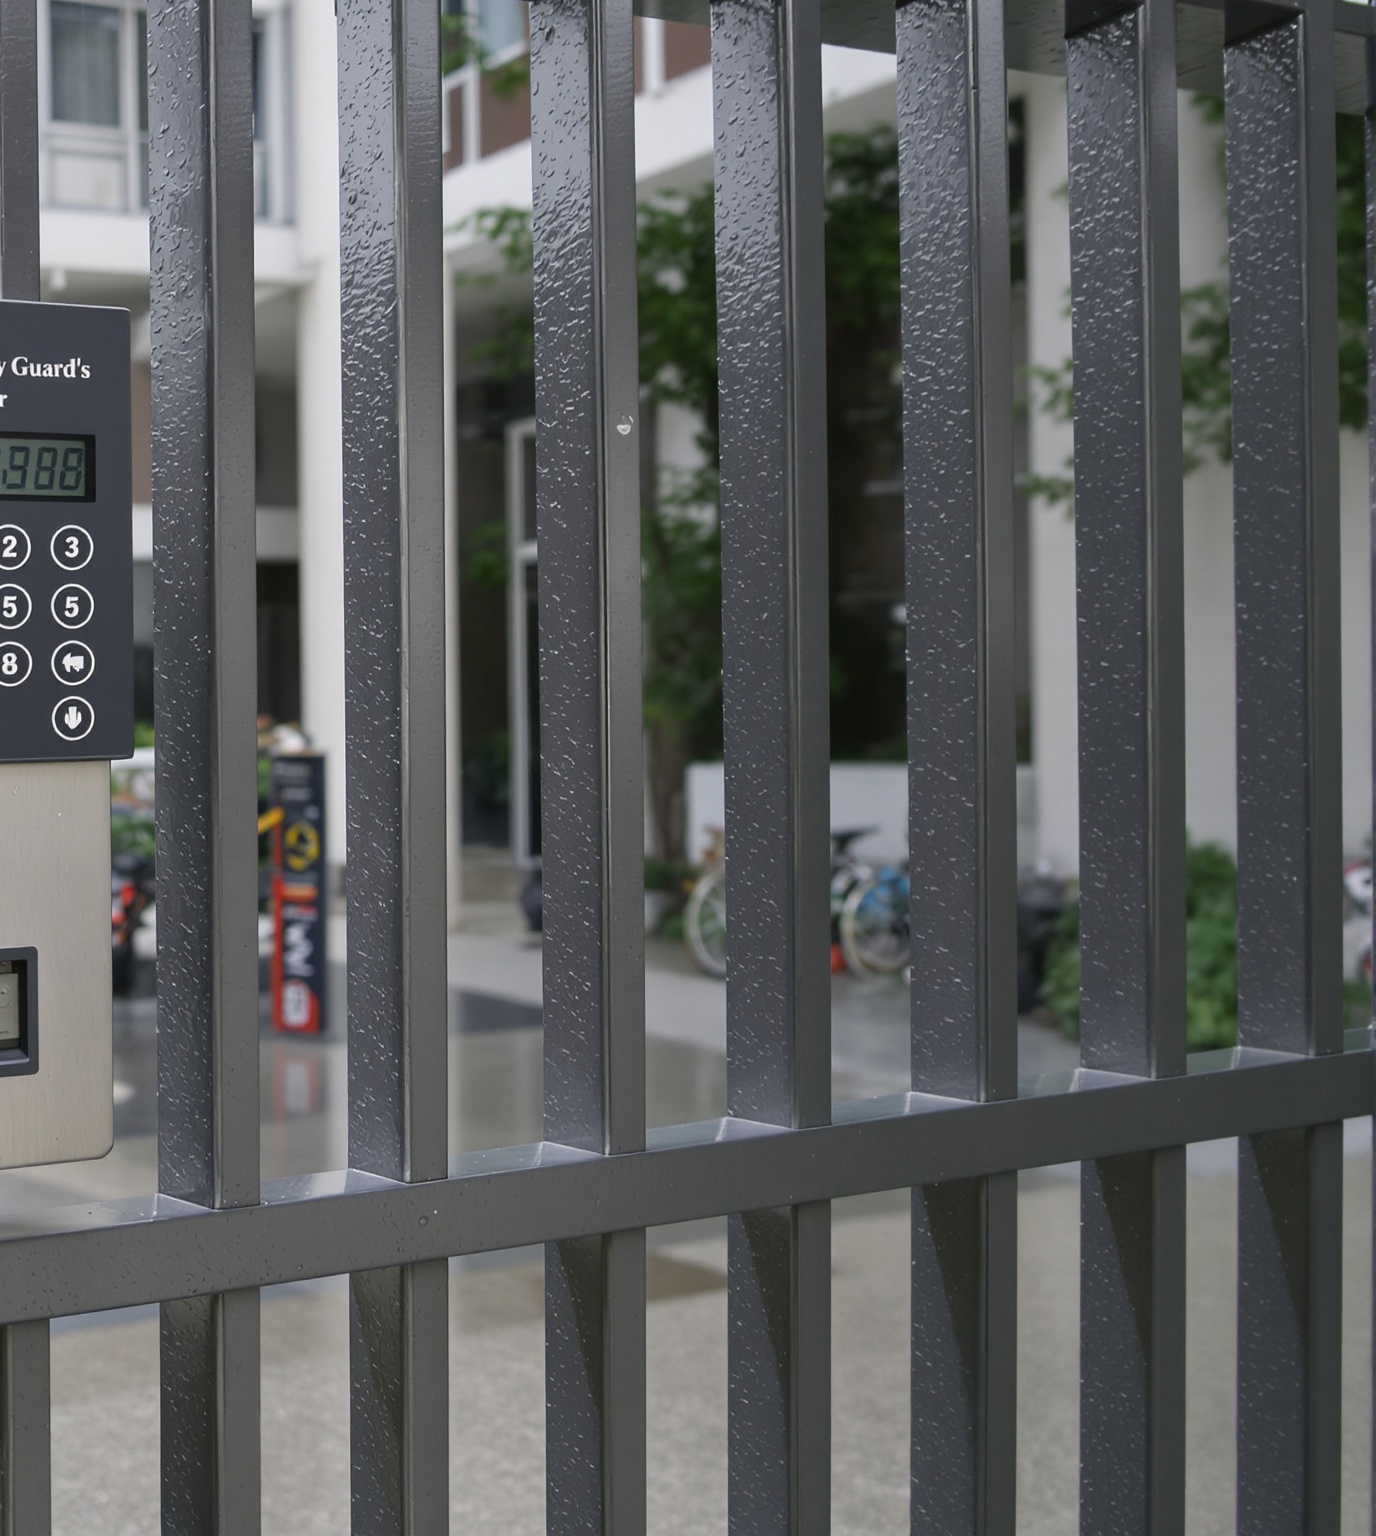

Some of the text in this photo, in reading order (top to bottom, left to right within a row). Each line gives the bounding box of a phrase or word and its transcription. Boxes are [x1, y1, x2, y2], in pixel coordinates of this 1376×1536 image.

[11, 356, 91, 379] Guard's
[2, 535, 18, 558] 2
[64, 536, 80, 558] 3
[2, 595, 18, 618] 5
[64, 596, 80, 618] 5
[1, 653, 19, 675] 8
